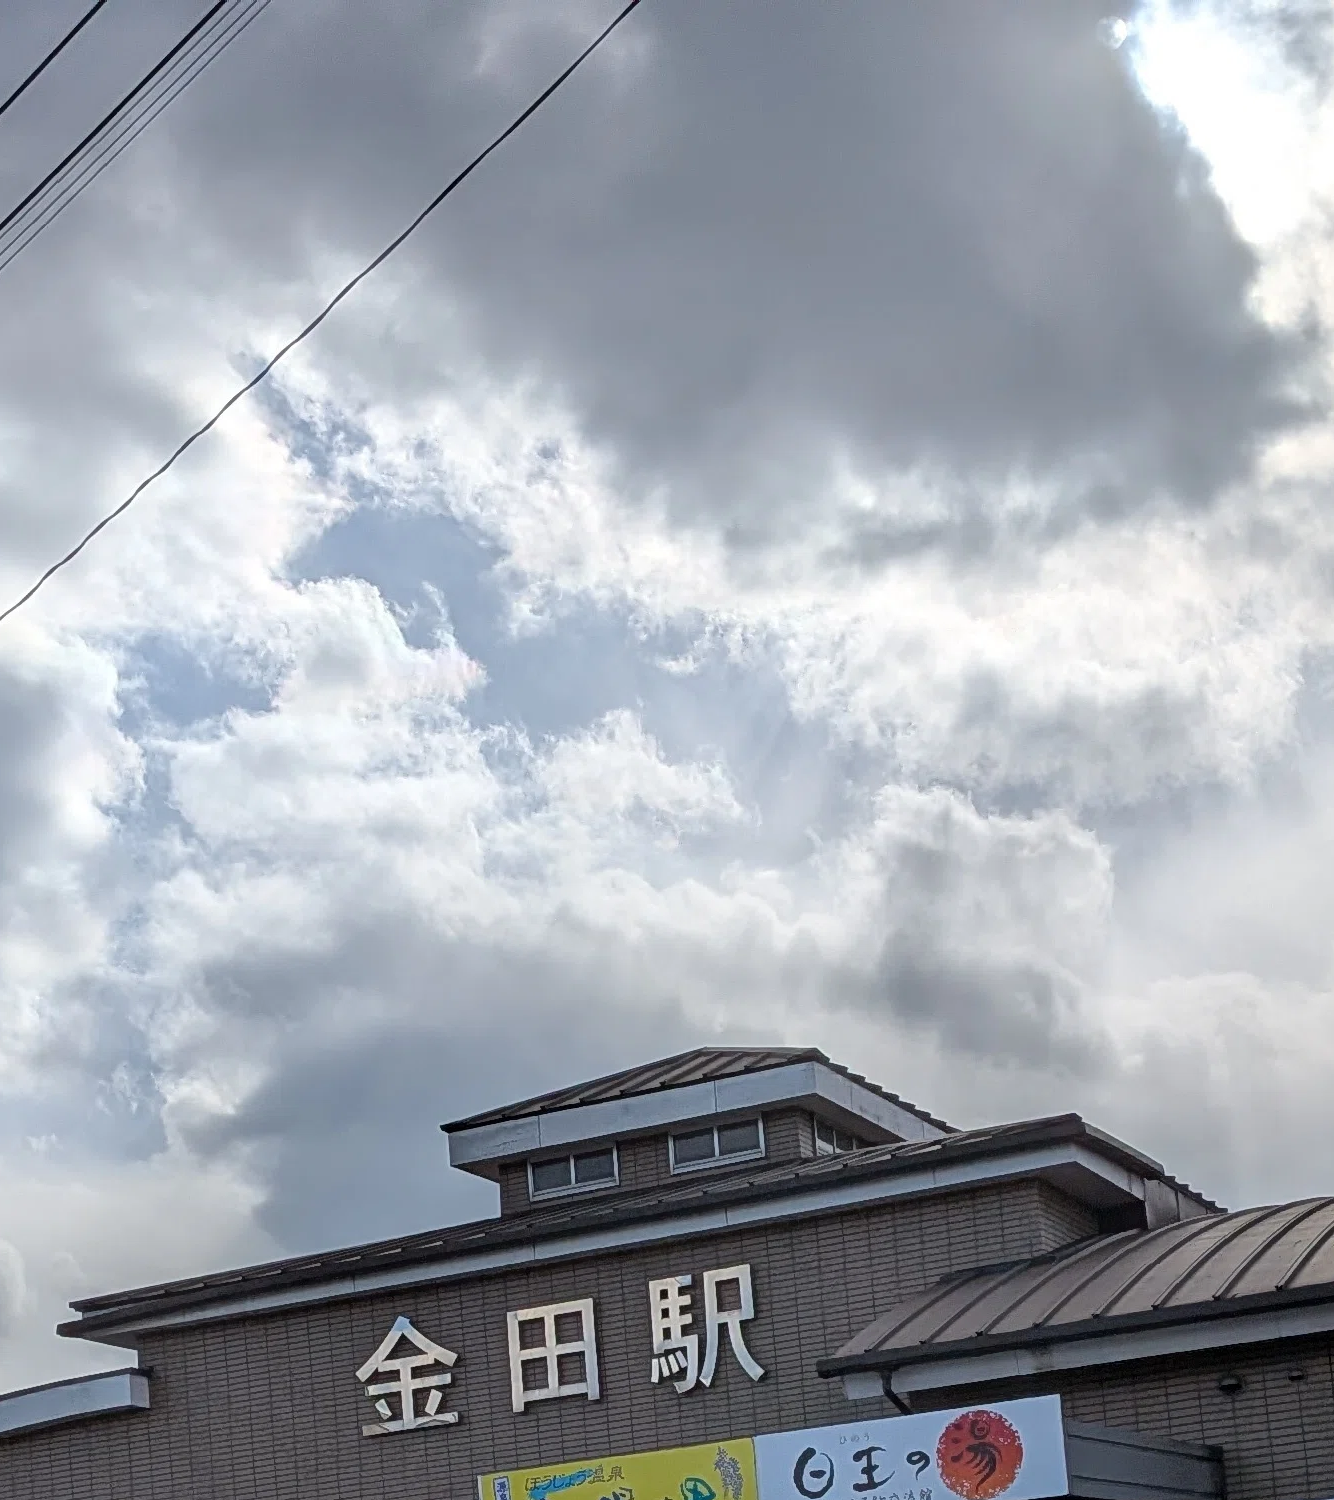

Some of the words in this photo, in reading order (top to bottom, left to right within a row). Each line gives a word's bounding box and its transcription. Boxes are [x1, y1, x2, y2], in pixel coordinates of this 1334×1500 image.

[354, 1263, 765, 1437] 金田駅
[525, 1464, 625, 1492] ほうじょう温泉
[793, 1418, 1004, 1500] 日王の湯
